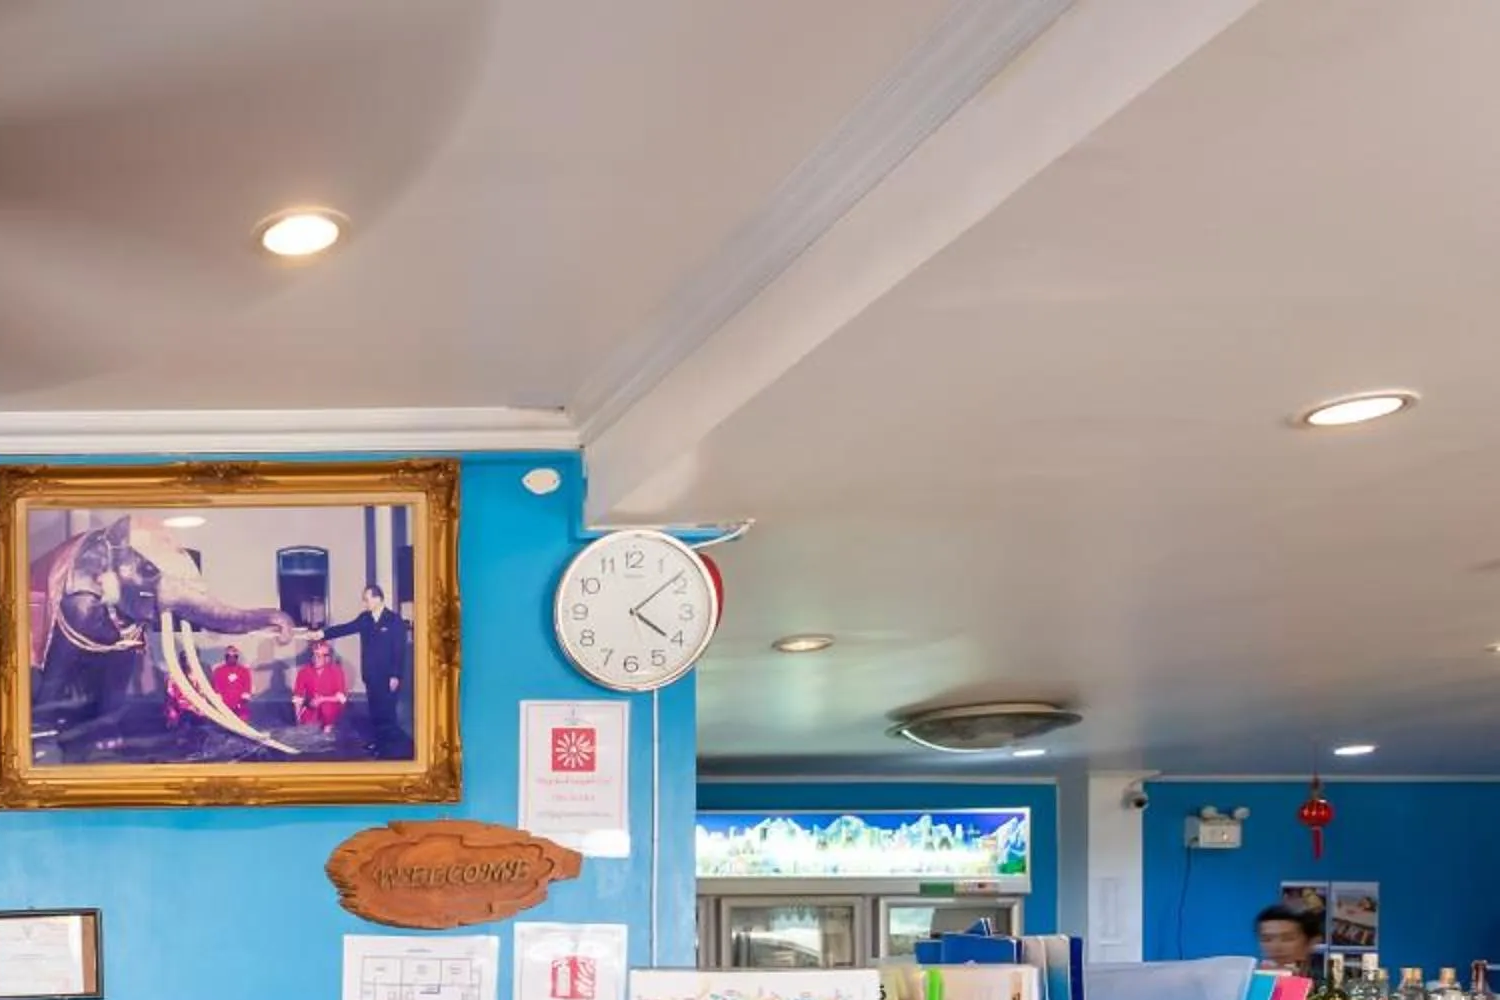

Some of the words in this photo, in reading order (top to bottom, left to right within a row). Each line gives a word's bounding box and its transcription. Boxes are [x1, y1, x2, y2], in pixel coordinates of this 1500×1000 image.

[601, 557, 615, 574] 11
[625, 550, 645, 569] 12
[658, 558, 665, 573] 1
[581, 577, 601, 596] 10
[673, 577, 688, 595] 2
[572, 603, 589, 621] 9
[679, 603, 695, 621] 3
[579, 629, 596, 647] 8
[670, 630, 684, 647] 4
[600, 648, 613, 666] 7
[623, 656, 639, 673] 6
[651, 650, 666, 667] 5
